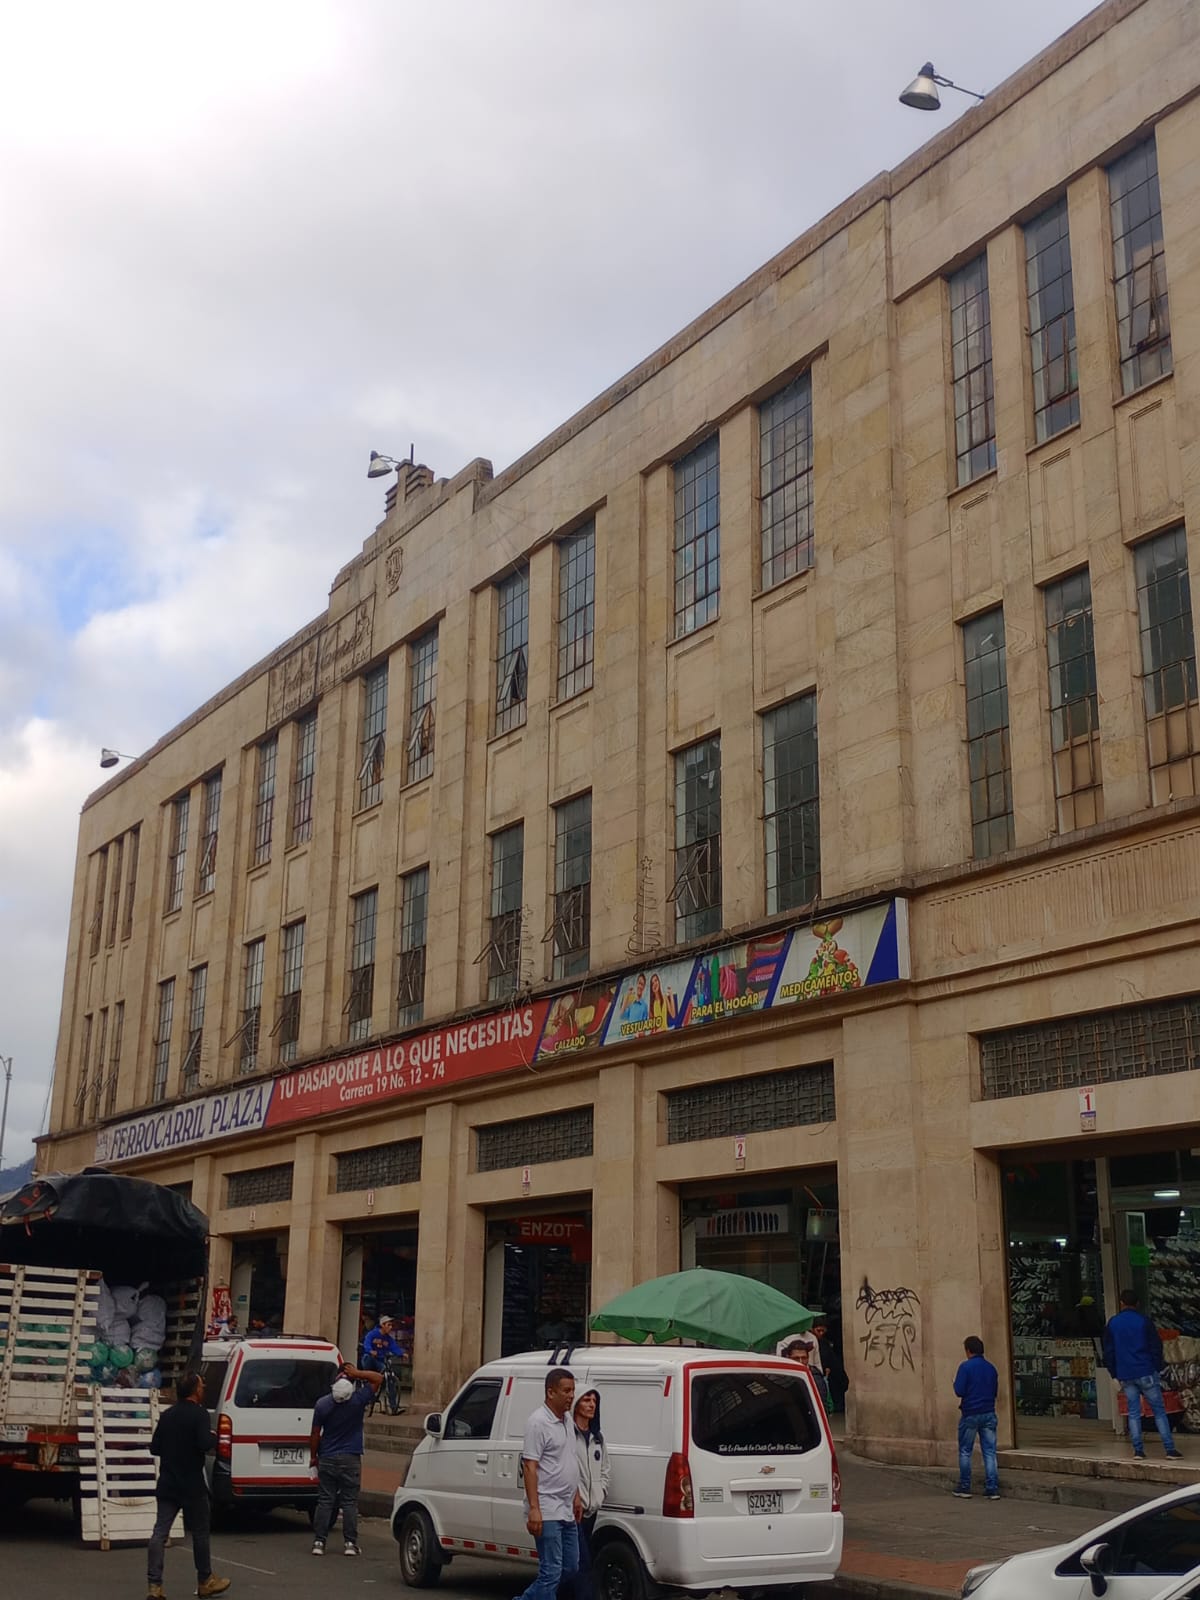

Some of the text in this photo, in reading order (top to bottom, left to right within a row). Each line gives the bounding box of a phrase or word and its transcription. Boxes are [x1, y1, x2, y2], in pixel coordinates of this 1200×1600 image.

[780, 968, 859, 999] MEDICAMENTOS
[691, 993, 759, 1019] PARA EL HOGAR
[621, 1016, 663, 1036] VESTUARIO
[279, 1009, 533, 1100] TU PASAPORTE A LO QUE NECESITAS
[554, 1035, 586, 1051] CALZADO
[340, 1083, 374, 1102] Carrera
[376, 1076, 388, 1093] 19
[390, 1073, 407, 1090] No.
[410, 1067, 422, 1086] 12
[432, 1061, 445, 1080] 74
[1084, 1093, 1091, 1111] 1
[109, 1086, 264, 1161] FERROCARRIL PLAZA
[737, 1143, 743, 1157] 2
